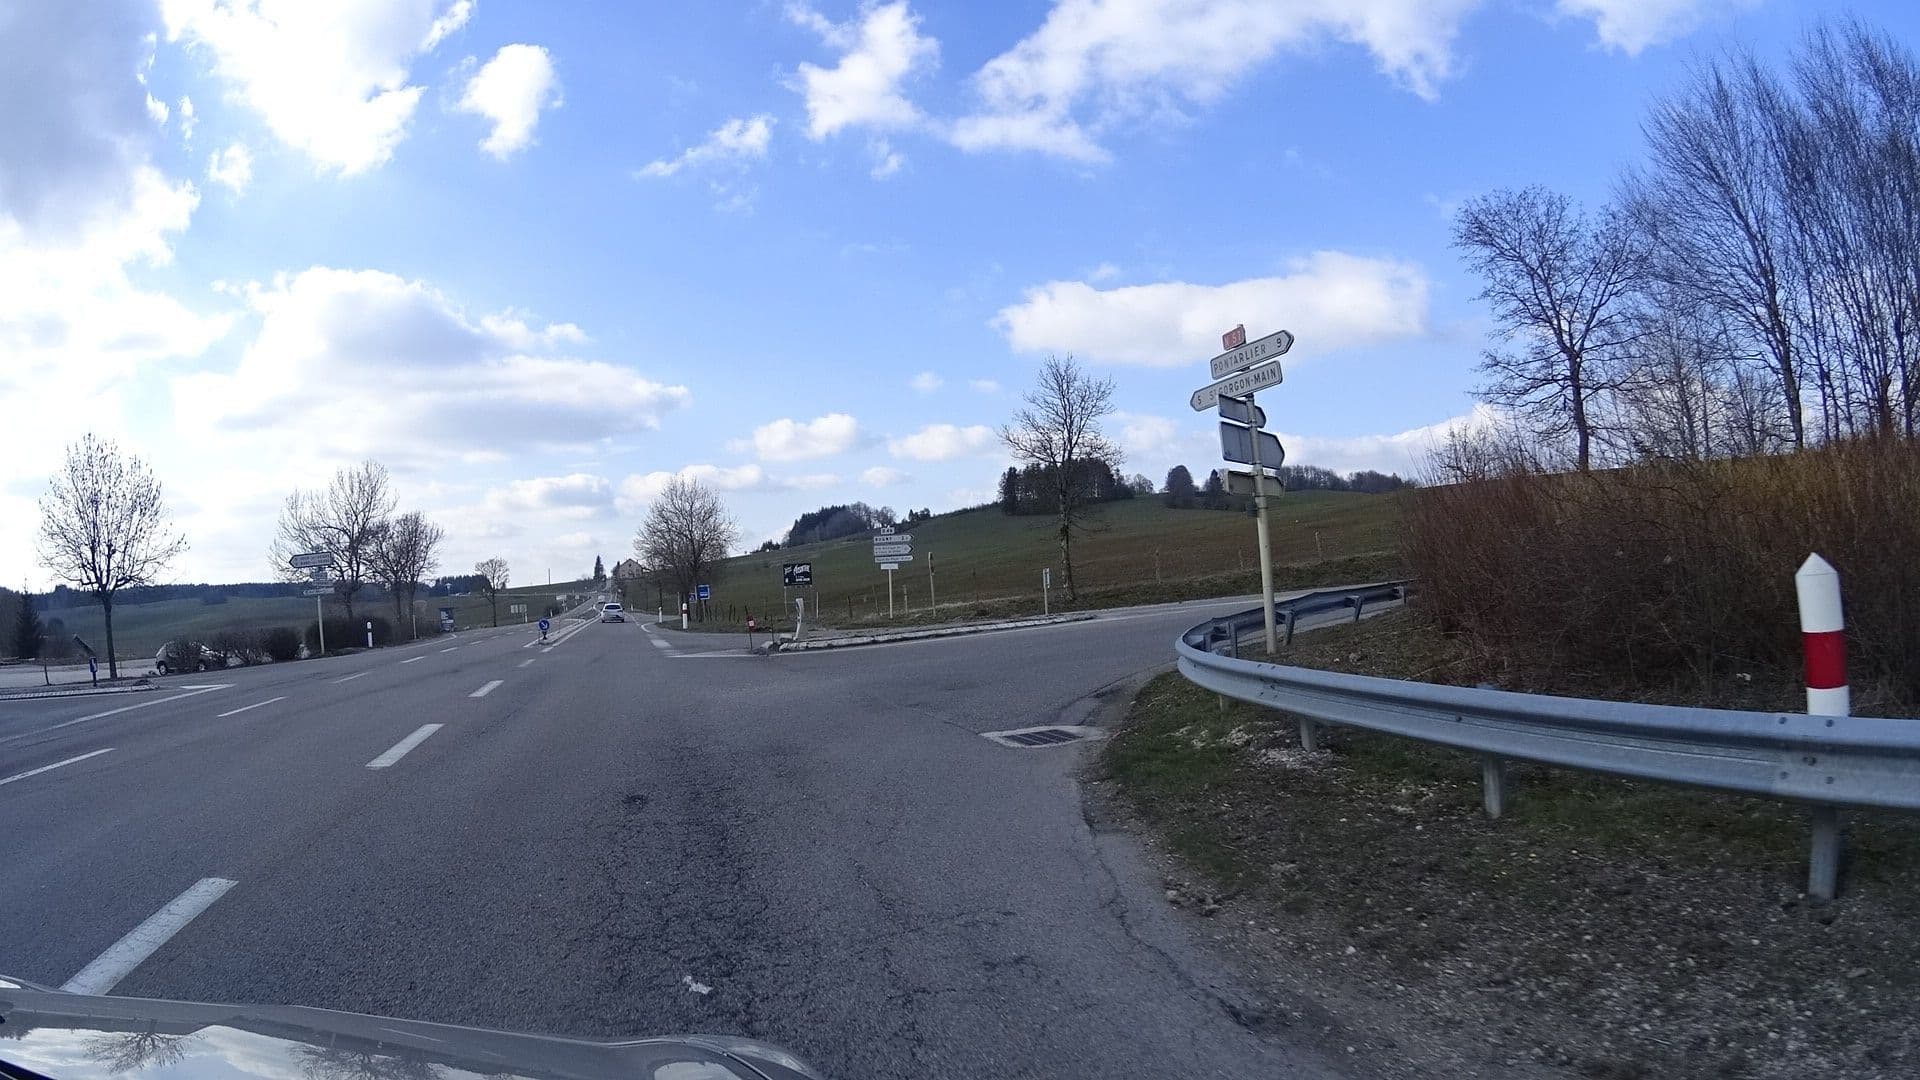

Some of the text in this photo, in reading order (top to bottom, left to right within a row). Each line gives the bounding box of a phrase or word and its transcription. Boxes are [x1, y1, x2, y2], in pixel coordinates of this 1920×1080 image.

[1213, 337, 1282, 372] PONTARLIER 9
[1231, 330, 1241, 344] 57
[1197, 395, 1202, 405] 5
[1218, 366, 1277, 395] GORGON-MAIN
